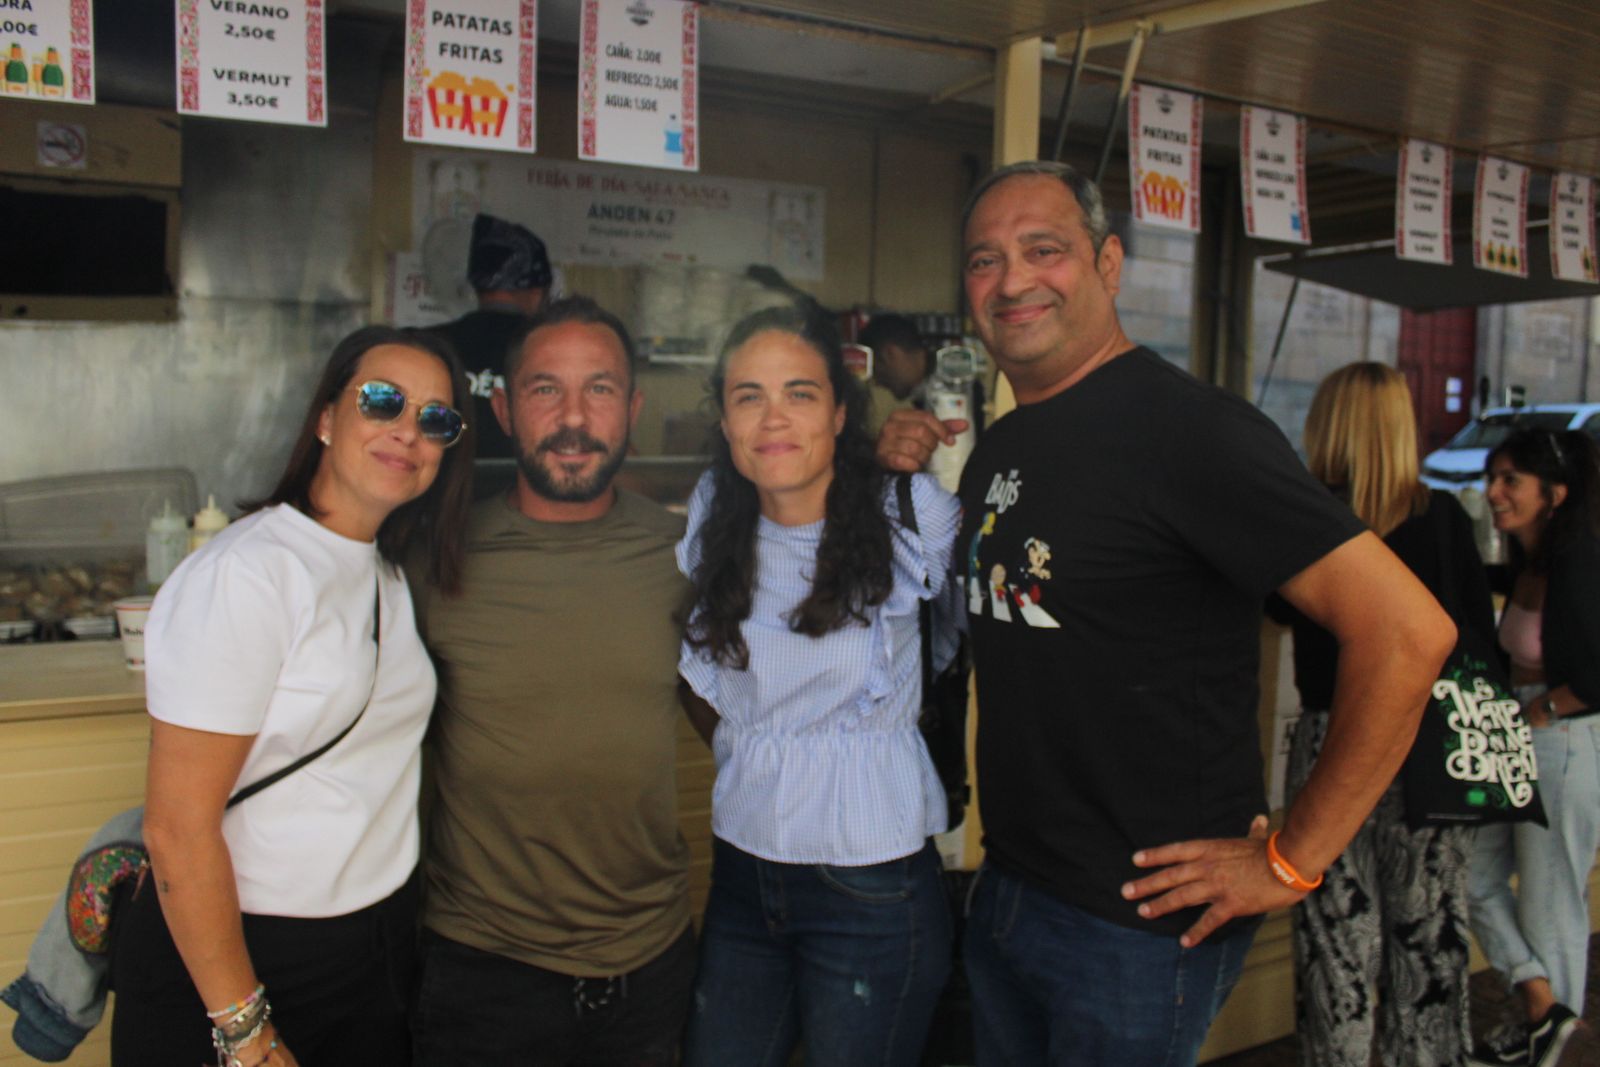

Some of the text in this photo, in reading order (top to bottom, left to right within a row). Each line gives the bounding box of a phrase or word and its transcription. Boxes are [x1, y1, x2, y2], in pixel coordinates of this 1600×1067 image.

[210, 0, 290, 20] VERANO
[223, 23, 277, 41] 2,50€
[431, 10, 513, 36] PATATAS
[438, 42, 504, 64] FRITAS
[212, 68, 293, 88] VERMUT
[605, 69, 653, 87] REFRESCO:
[226, 92, 280, 108] 3,50€
[604, 94, 632, 109] AGUA:
